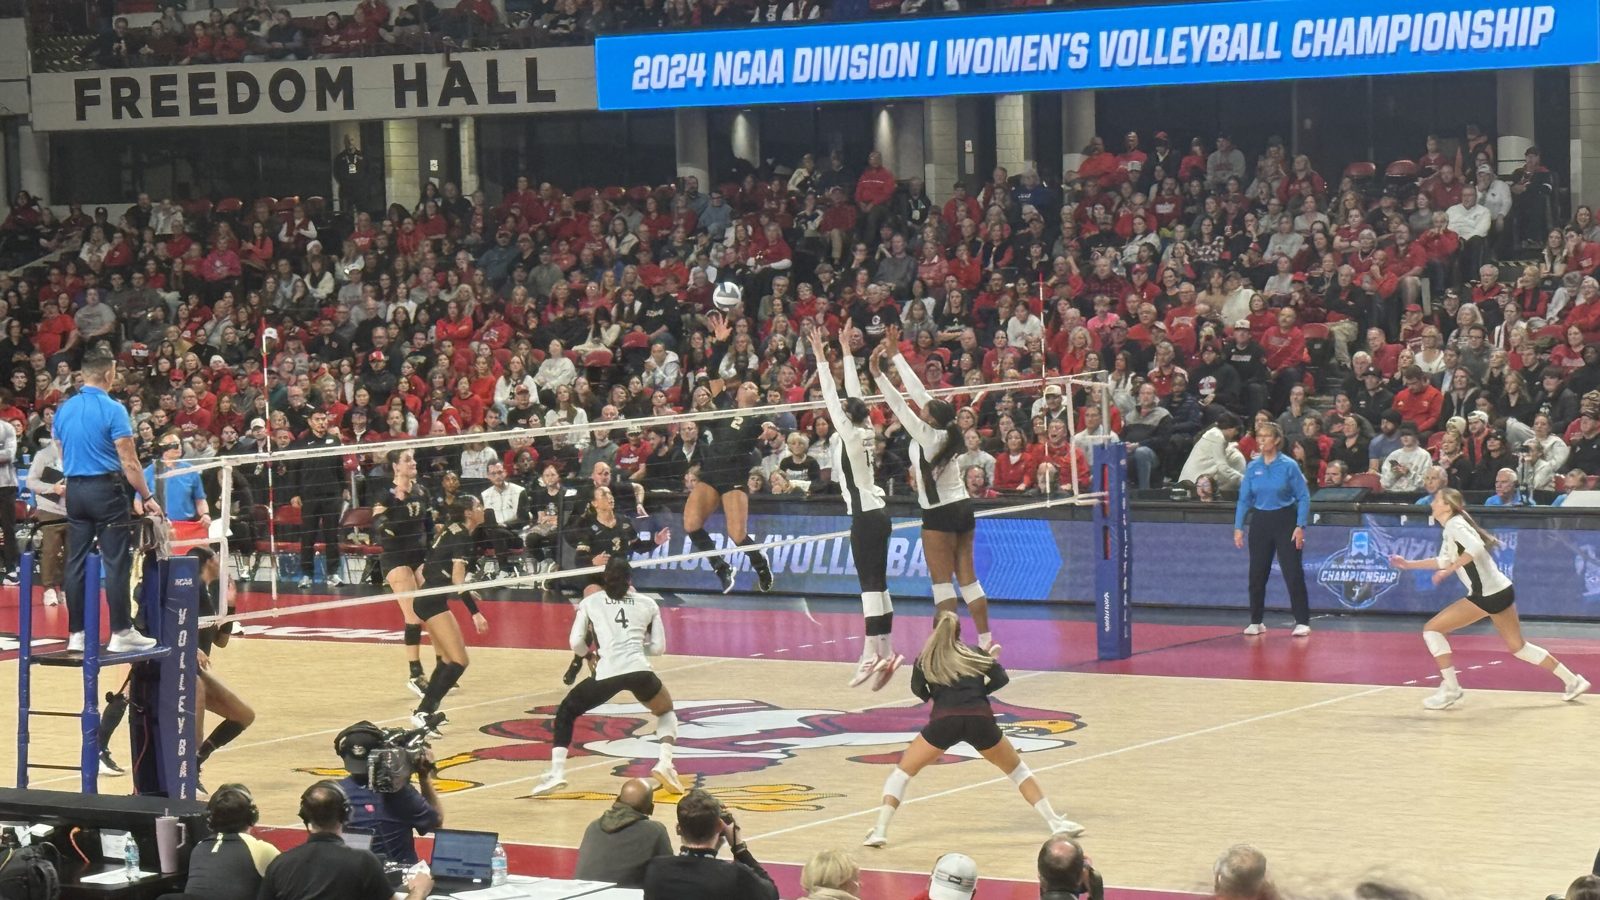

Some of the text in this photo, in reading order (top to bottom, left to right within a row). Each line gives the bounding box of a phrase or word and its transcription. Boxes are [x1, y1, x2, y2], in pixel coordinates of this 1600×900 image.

[632, 6, 1556, 90] 2024 NCAA DIVISION I WOMEN'S VOLLEYBALL CHAMPIONSHIP
[74, 57, 557, 121] FREEDOM HALL
[1320, 570, 1398, 584] CHAMPIONSHIP
[614, 607, 629, 629] 4
